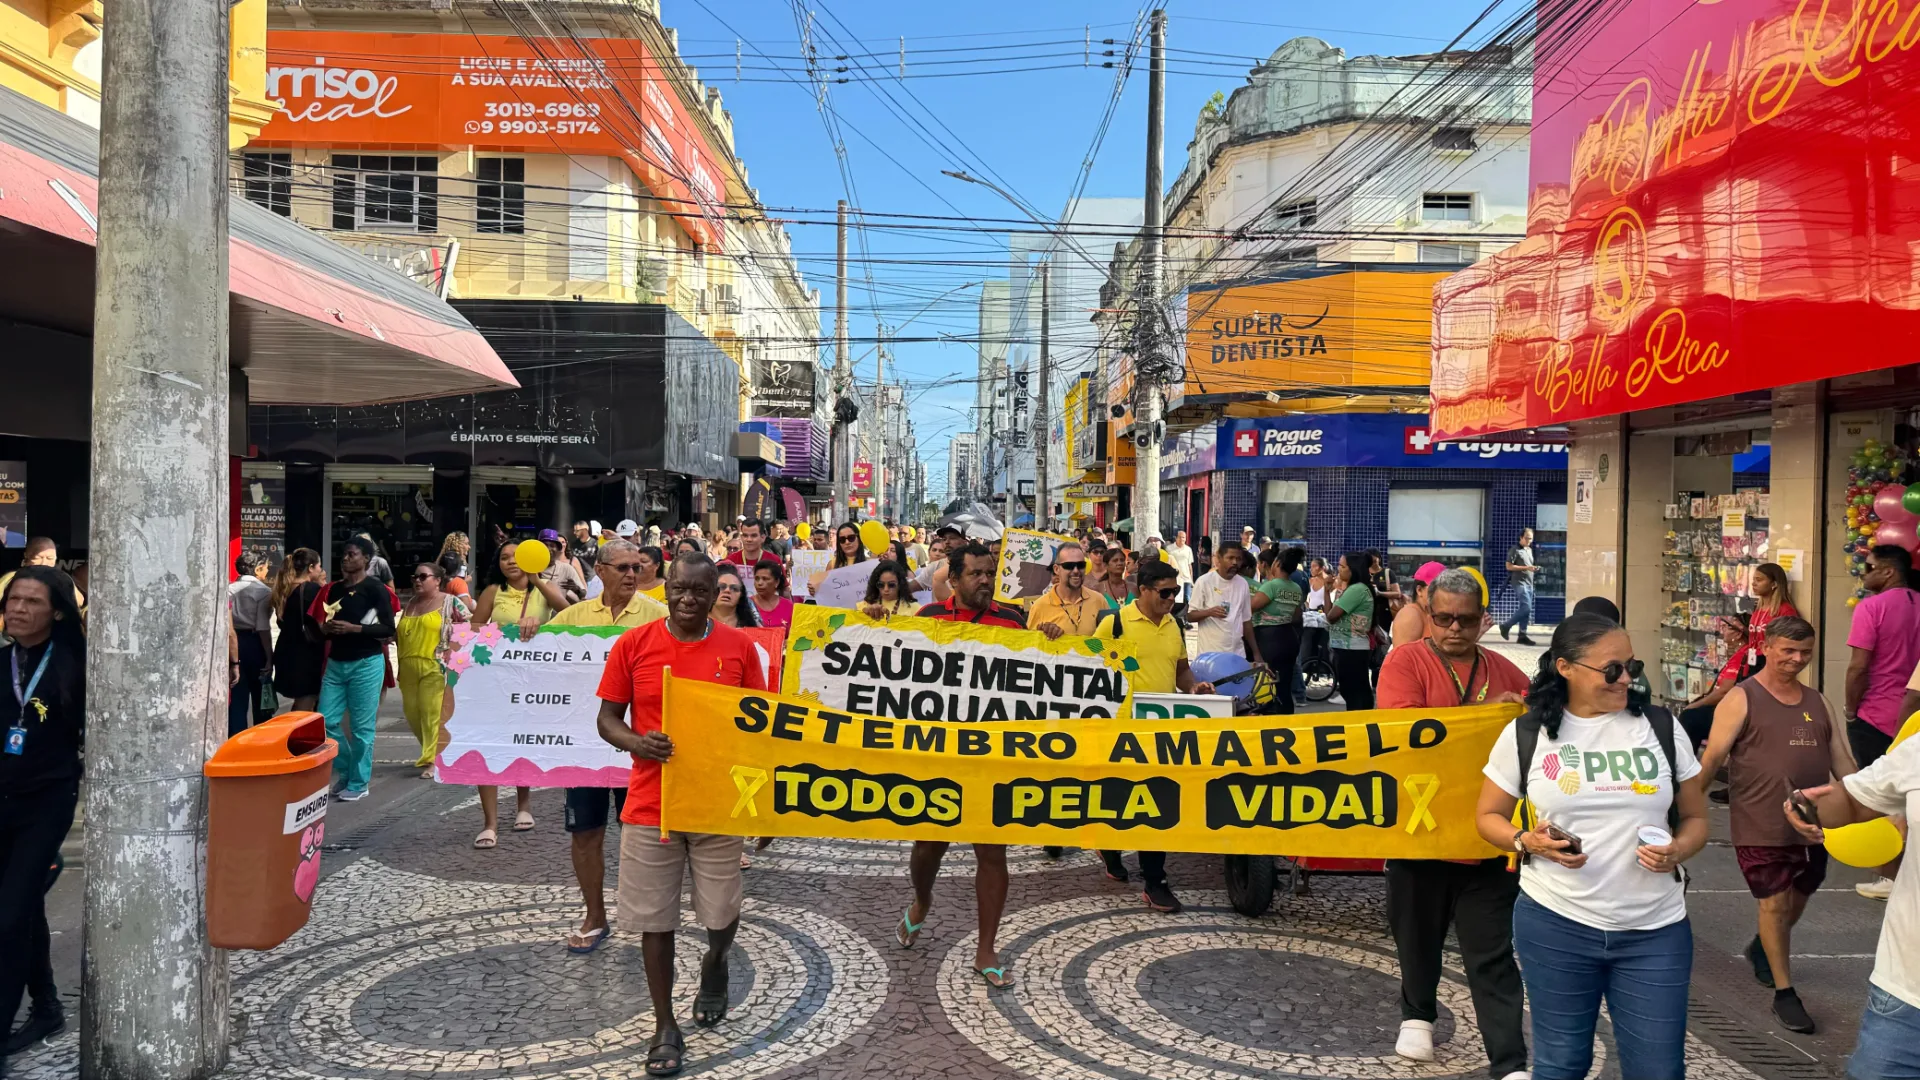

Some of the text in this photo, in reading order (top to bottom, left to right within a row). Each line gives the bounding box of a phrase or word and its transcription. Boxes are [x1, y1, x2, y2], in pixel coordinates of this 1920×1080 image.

[266, 57, 379, 99] rriso
[459, 57, 606, 73] LIGUE E AGENDE
[451, 73, 465, 86] A
[469, 73, 506, 86] SUA
[485, 102, 600, 118] 3019-6969
[1586, 40, 1730, 196] Bella
[481, 120, 601, 134] 9 9903-5174
[1212, 312, 1284, 340] SUPER
[1211, 334, 1328, 364] DENTISTA
[1534, 307, 1730, 414] Bella Rica
[450, 432, 458, 442] É
[460, 433, 504, 443] BARATO
[506, 434, 513, 443] E
[516, 434, 558, 444] SEMPRE
[561, 432, 590, 444] SERÁ
[1263, 443, 1322, 456] Menos
[1264, 429, 1323, 445] Pague
[822, 639, 1126, 704] SAÚDE MENTAL
[511, 693, 571, 705] E CUIDE
[513, 733, 574, 746] MENTAL
[734, 696, 1448, 767] SETEMBRO AMARELO
[1583, 747, 1659, 783] PRD
[295, 793, 328, 823] EMSURB
[776, 771, 1385, 826] TODOS PELA VIDA!
